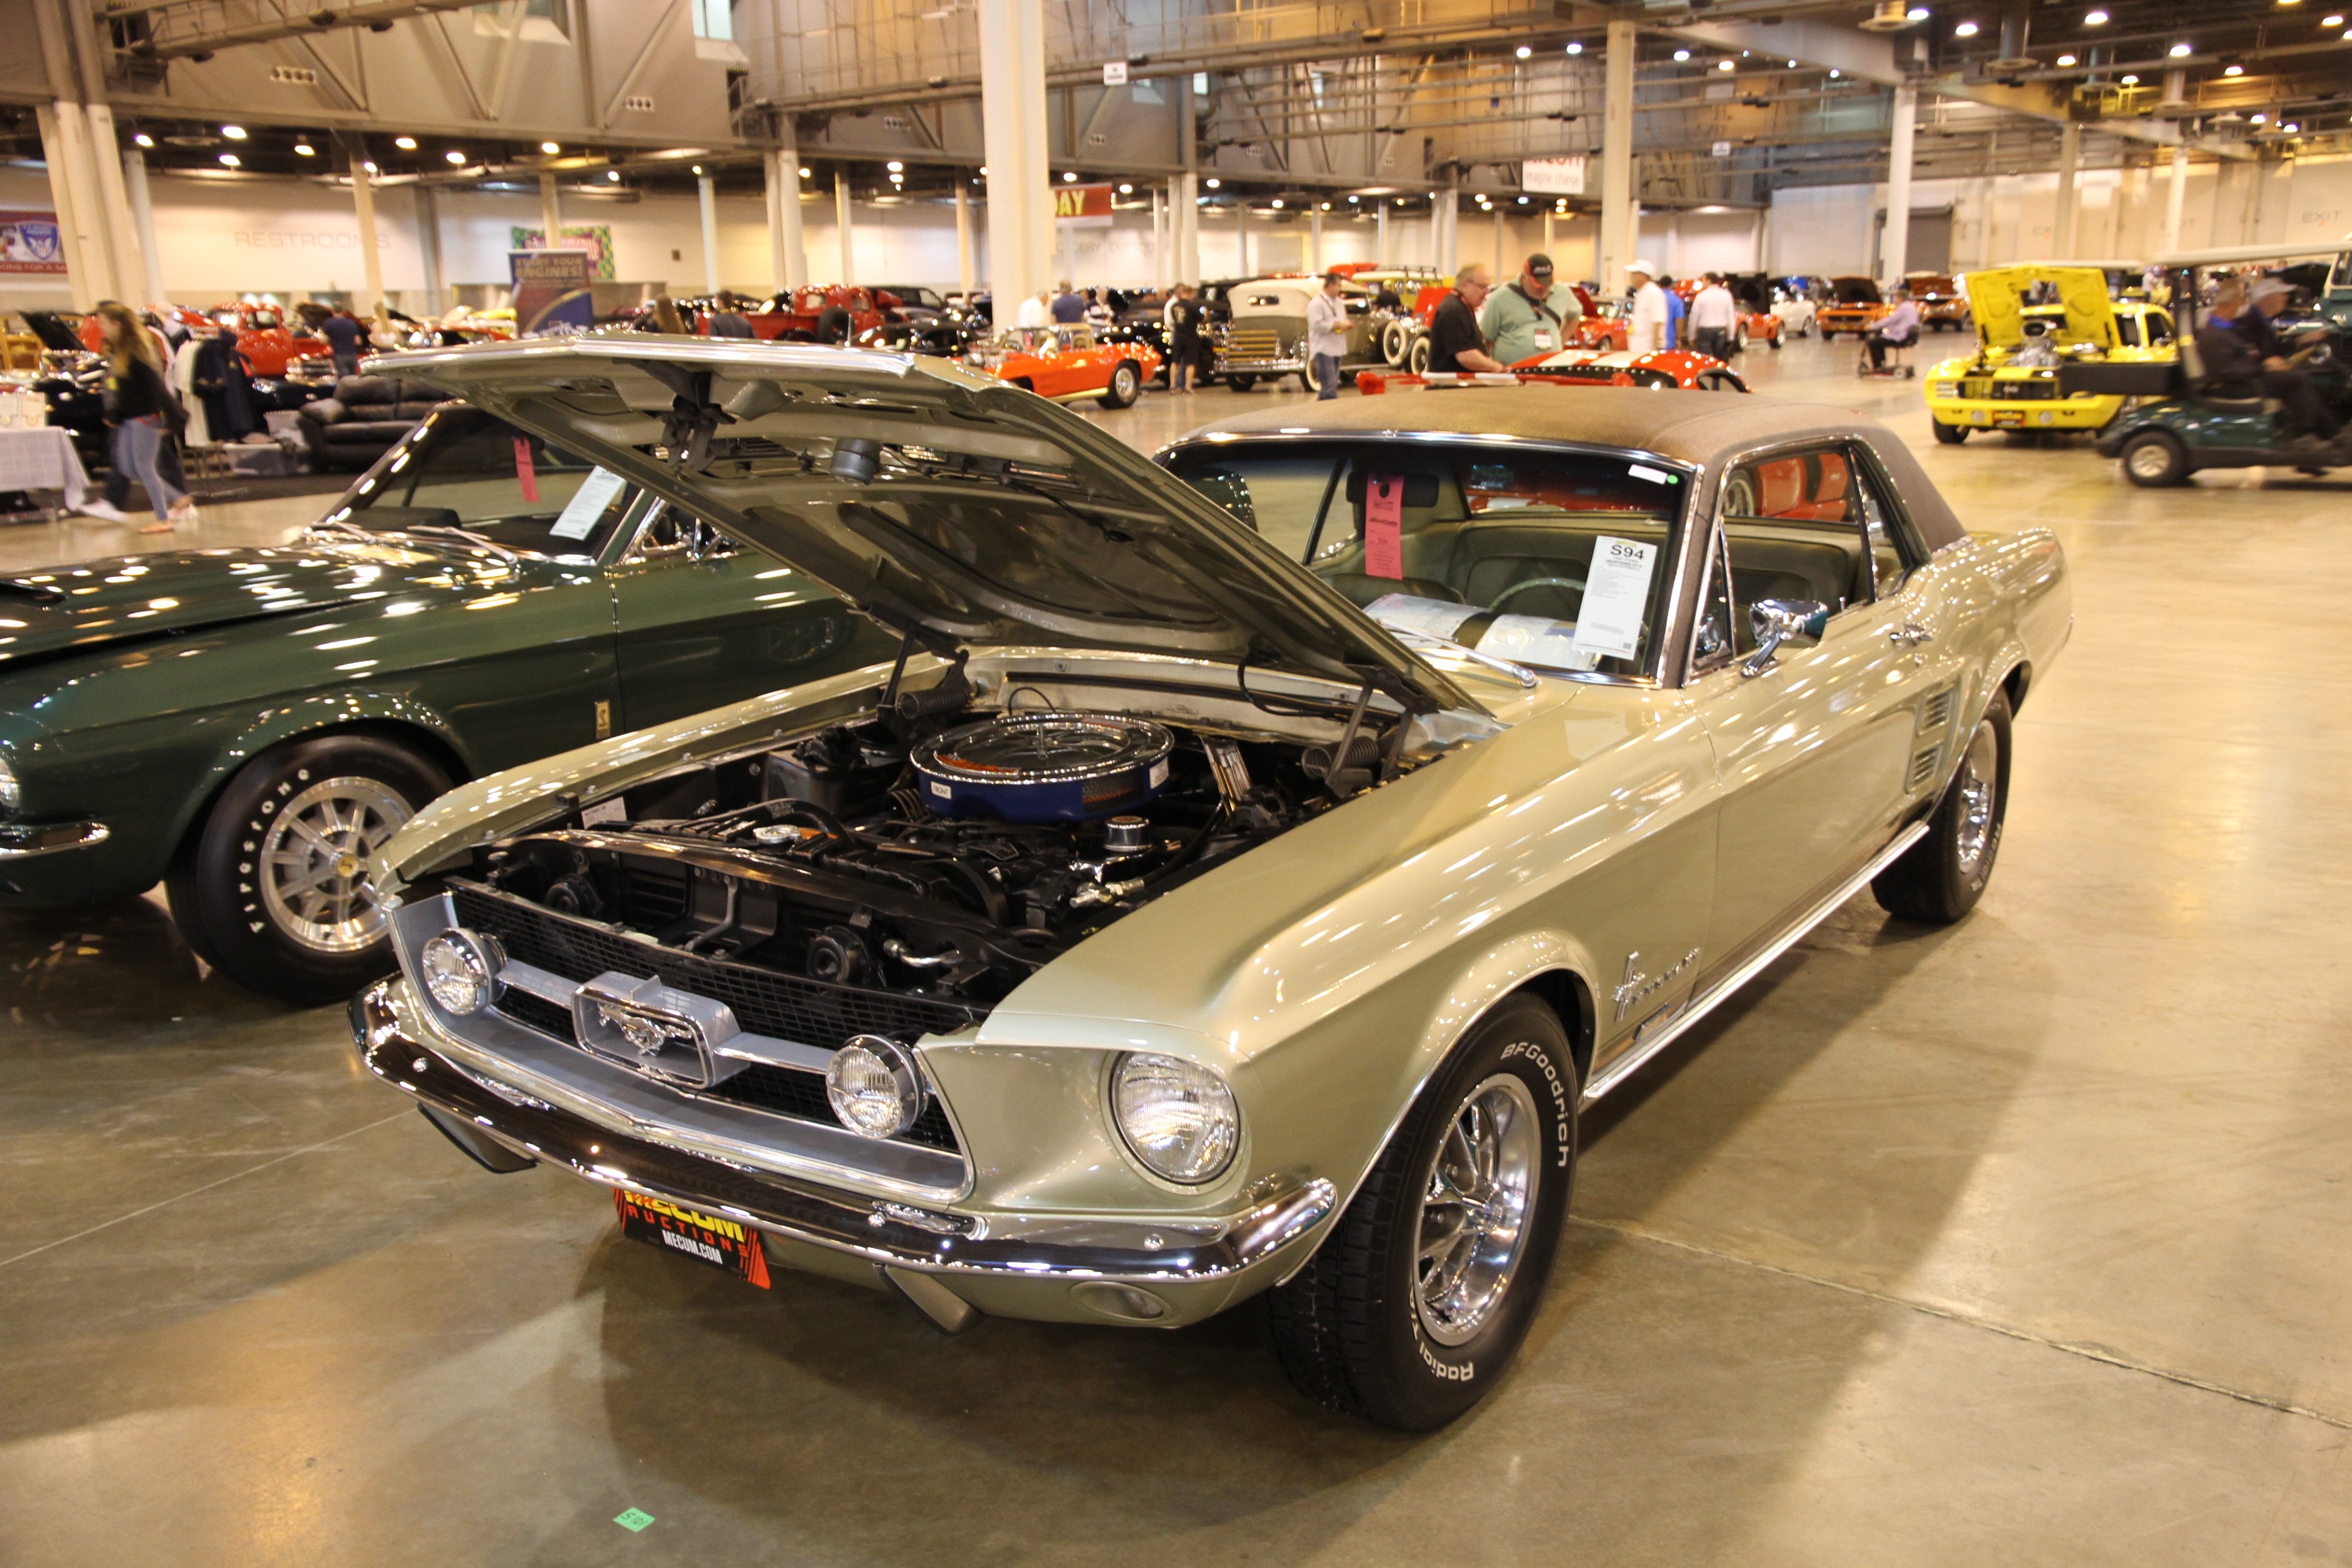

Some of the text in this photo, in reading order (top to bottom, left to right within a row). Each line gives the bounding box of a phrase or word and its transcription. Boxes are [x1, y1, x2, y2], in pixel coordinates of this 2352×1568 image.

[1056, 190, 1085, 216] AY
[1610, 544, 1644, 560] S94
[932, 785, 948, 795] FRONT
[1500, 1042, 1569, 1167] BFGoodrich
[627, 1205, 749, 1258] AUCTIONS
[662, 1229, 723, 1264] MECUM.COM
[1419, 1341, 1474, 1382] Radial
